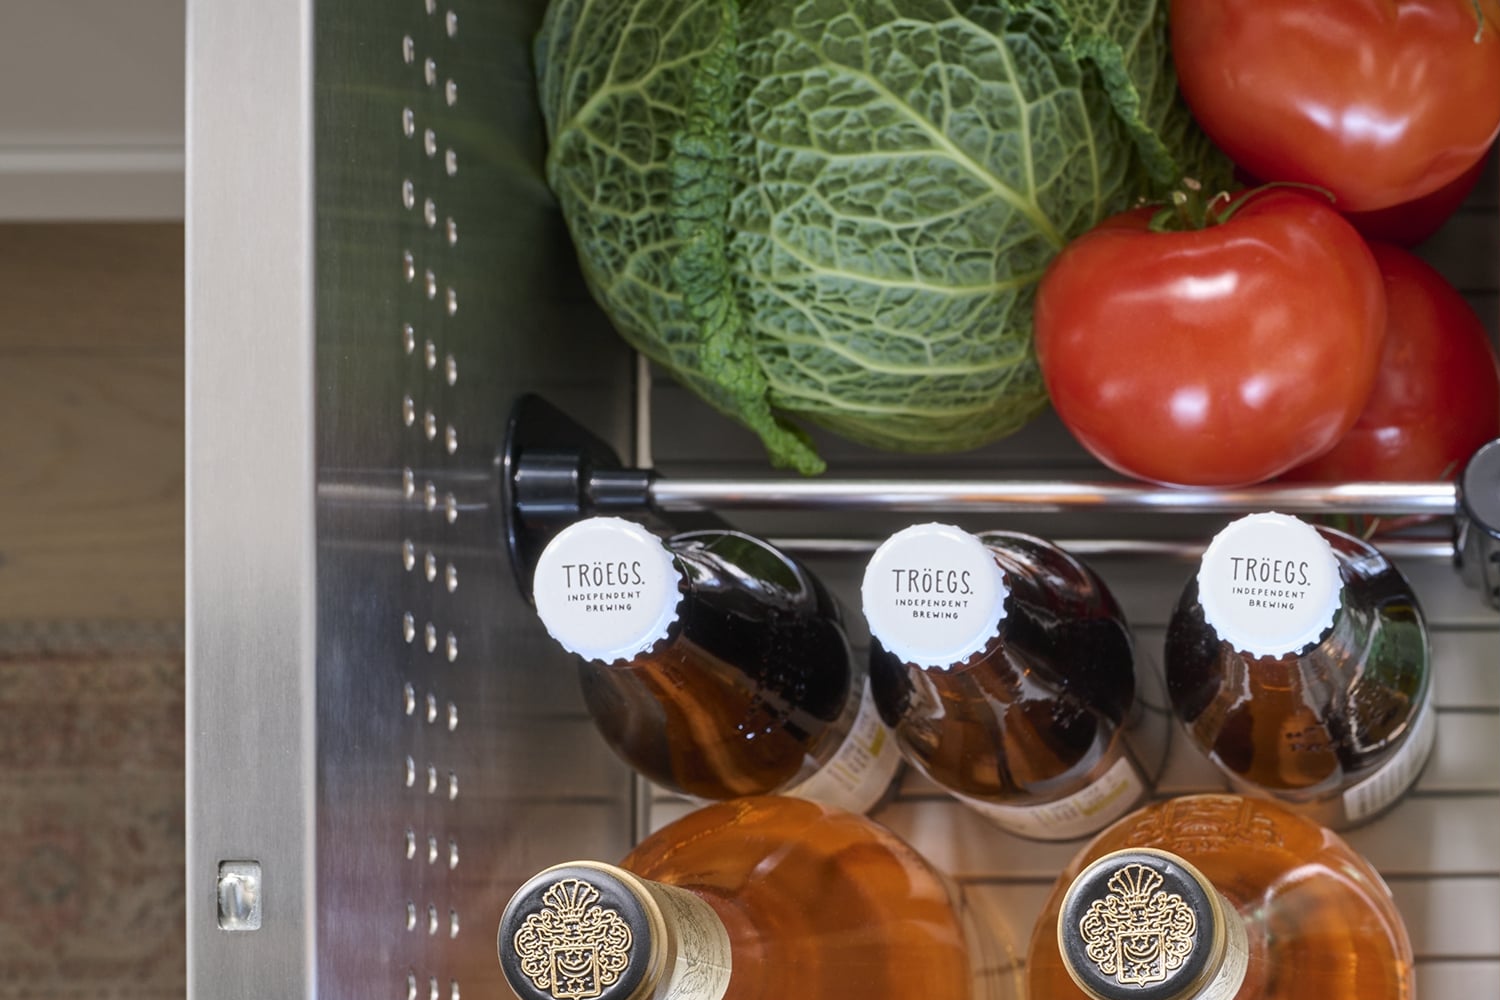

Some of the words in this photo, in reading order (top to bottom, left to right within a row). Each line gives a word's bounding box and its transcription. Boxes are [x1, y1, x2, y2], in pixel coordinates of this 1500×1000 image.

[561, 561, 645, 588] TRÖEGS.
[1230, 557, 1311, 586] TRÖEGS.
[891, 568, 973, 595] TRÖEGS.
[567, 591, 641, 602] INDEPENDENT
[1232, 587, 1305, 599] INDEPENDENT
[586, 603, 632, 612] BREWING
[895, 599, 968, 608] INDEPENDENT
[1249, 599, 1295, 610] BREWING
[912, 610, 959, 620] BREWING
